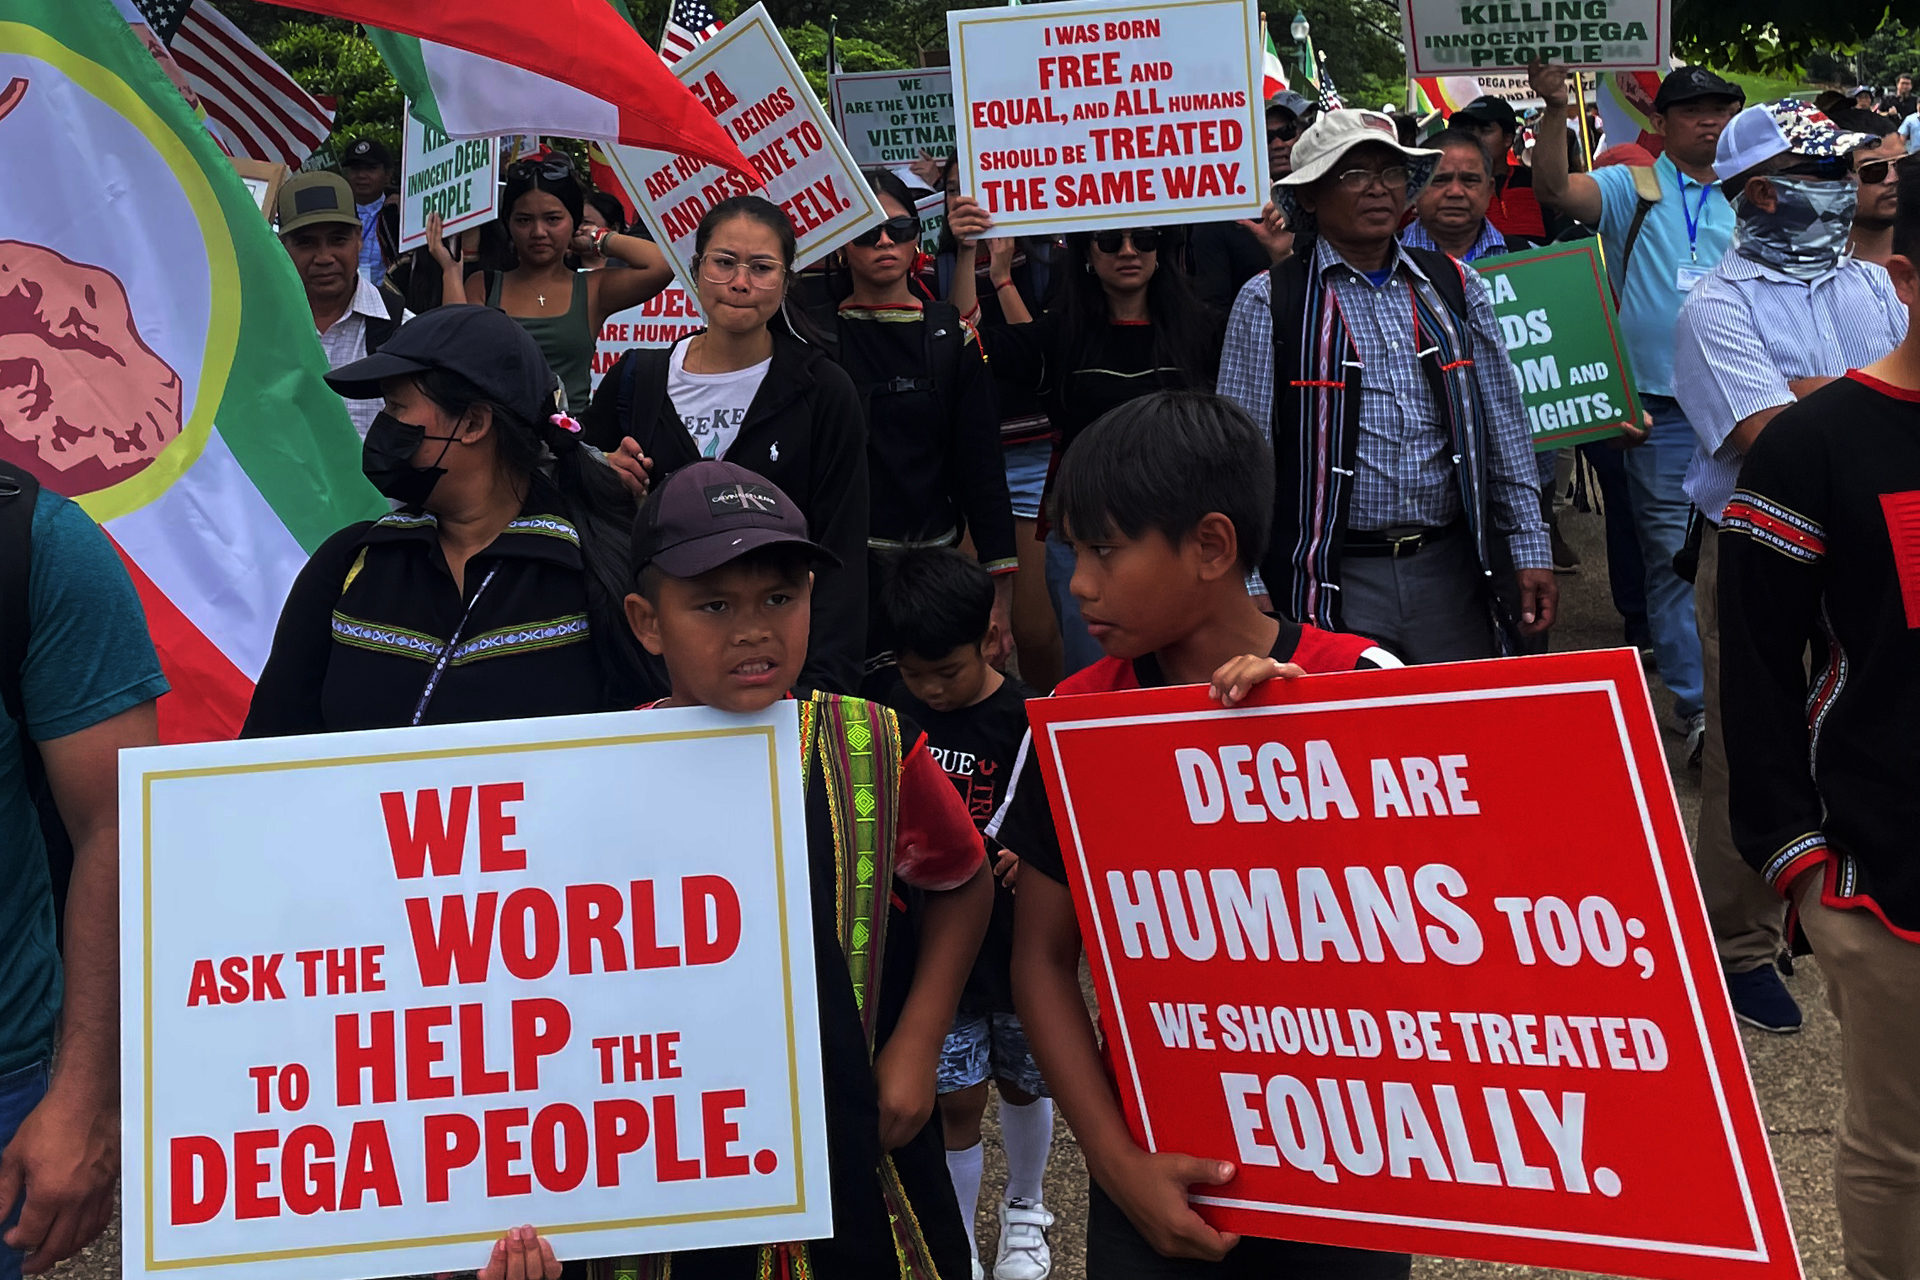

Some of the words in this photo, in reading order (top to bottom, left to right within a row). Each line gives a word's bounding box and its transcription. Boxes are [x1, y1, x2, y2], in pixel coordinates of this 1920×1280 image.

[1045, 28, 1051, 46] I
[1056, 23, 1100, 45] WAS
[1105, 19, 1160, 41] BORN
[1425, 31, 1549, 48] INNOCENT
[1555, 22, 1648, 43] DEGA
[1461, 0, 1607, 25] KILLING
[1038, 52, 1122, 90] FREE
[1130, 62, 1173, 83] AND
[1472, 45, 1602, 66] PEOPLE
[845, 102, 874, 114] ARE
[876, 99, 904, 111] THE
[906, 93, 954, 110] VICTI
[898, 78, 922, 91] WE
[972, 97, 1069, 129] EQUAL,
[1073, 102, 1109, 120] AND
[1114, 89, 1164, 117] ALL
[1169, 92, 1246, 112] HUMANS
[890, 114, 908, 125] OF
[911, 112, 939, 124] THE
[408, 158, 453, 197] INNOCENT
[455, 138, 489, 178] DEGA
[644, 164, 680, 202] ARE
[730, 86, 796, 142] BEINGS
[881, 148, 919, 160] CIVIL
[980, 147, 1057, 171] SHOULD
[1063, 145, 1086, 164] BE
[1089, 119, 1243, 161] TREATED
[423, 178, 472, 228] PEOPLE
[660, 196, 707, 243] AND
[786, 120, 823, 158] TO
[982, 177, 1048, 213] THE
[1055, 169, 1156, 208] SAME
[1162, 163, 1246, 199] WAY.
[1570, 362, 1608, 385] AND
[1526, 392, 1622, 434] IGHTS.
[1175, 738, 1359, 824] DEGA
[1371, 754, 1480, 818] ARE
[380, 782, 527, 880] WE
[187, 953, 286, 1007] ASK
[296, 945, 386, 998] THE
[405, 874, 742, 987] WORLD
[1106, 863, 1483, 965] HUMANS
[1494, 895, 1656, 979] TOO;
[249, 1063, 310, 1114] TO
[335, 997, 572, 1107] HELP
[592, 1032, 682, 1084] THE
[1149, 1002, 1215, 1050] WE
[1218, 1004, 1382, 1059] SHOULD
[1389, 1010, 1451, 1062] BE
[1450, 1012, 1669, 1071] TREATED
[170, 1119, 403, 1226] DEGA
[424, 1088, 778, 1204] PEOPLE.
[1220, 1072, 1622, 1198] EQUALLY.
